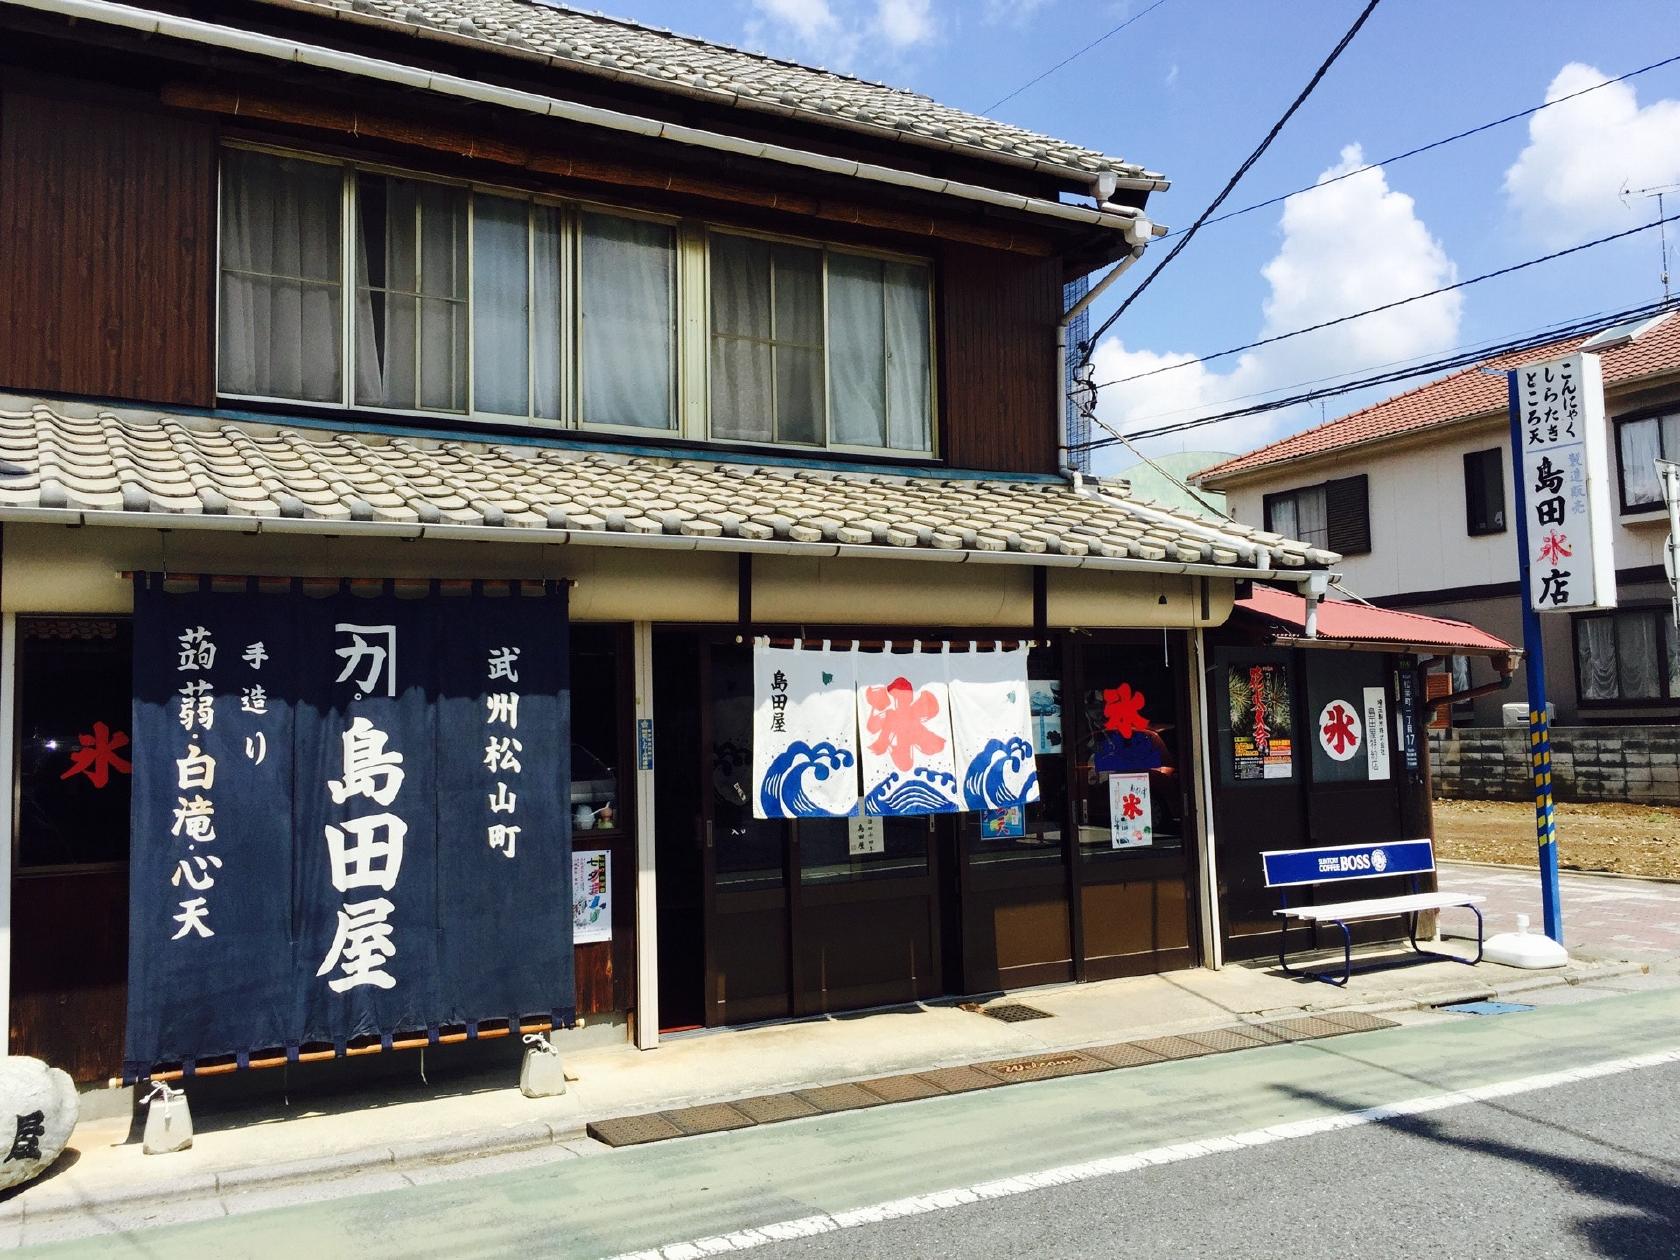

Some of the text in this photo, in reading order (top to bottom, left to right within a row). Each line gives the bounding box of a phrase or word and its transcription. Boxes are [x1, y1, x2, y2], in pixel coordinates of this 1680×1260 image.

[1526, 371, 1545, 445] ところ天
[1544, 367, 1560, 442] しらたき
[1561, 363, 1578, 438] こんにゃく
[1568, 452, 1586, 514] 製造販売
[1535, 456, 1573, 606] 島田氷店
[241, 641, 269, 766] 手造り
[770, 669, 788, 733] 島田屋
[866, 676, 946, 772] 氷
[1103, 682, 1150, 739] 氷
[1323, 704, 1357, 755] 氷
[61, 721, 132, 788] 氷
[483, 646, 522, 859] 武州松山町
[1406, 734, 1415, 746] 17
[1122, 793, 1143, 820] 氷
[316, 717, 408, 994] 島田屋
[1319, 853, 1371, 872] COFFEE BOSS
[3, 1109, 45, 1164] 屋
